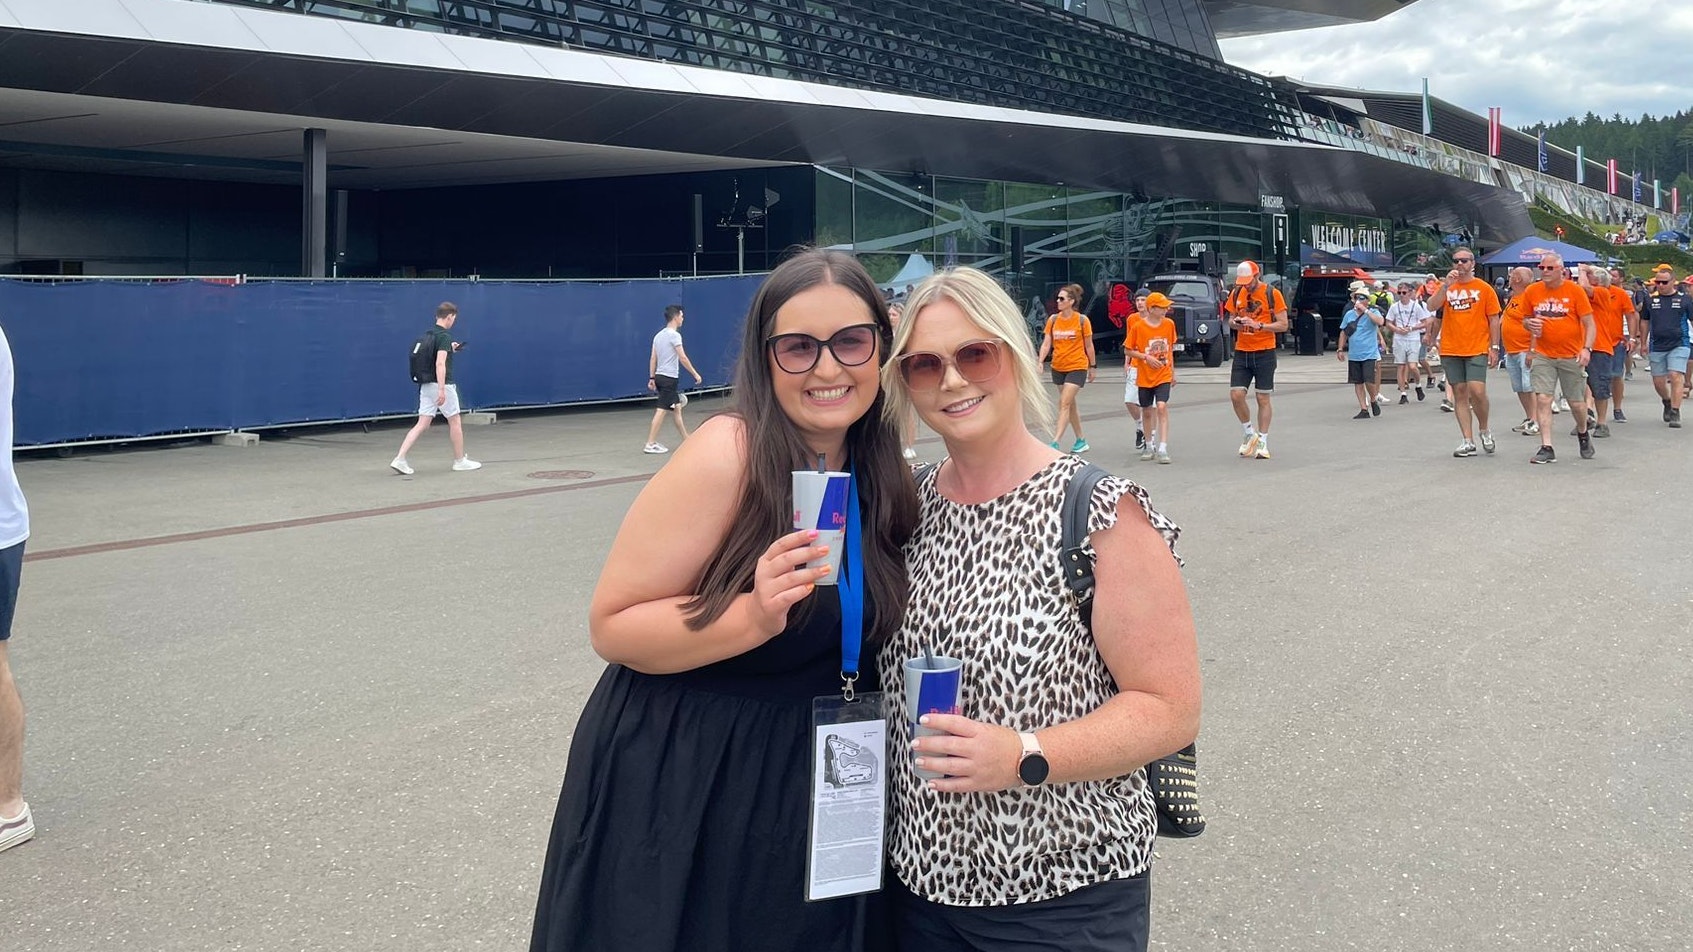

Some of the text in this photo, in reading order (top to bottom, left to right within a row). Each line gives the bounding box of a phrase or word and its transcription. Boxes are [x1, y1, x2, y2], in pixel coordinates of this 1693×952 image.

[1311, 224, 1386, 253] WELCOME CENTER
[1446, 289, 1481, 302] MAX
